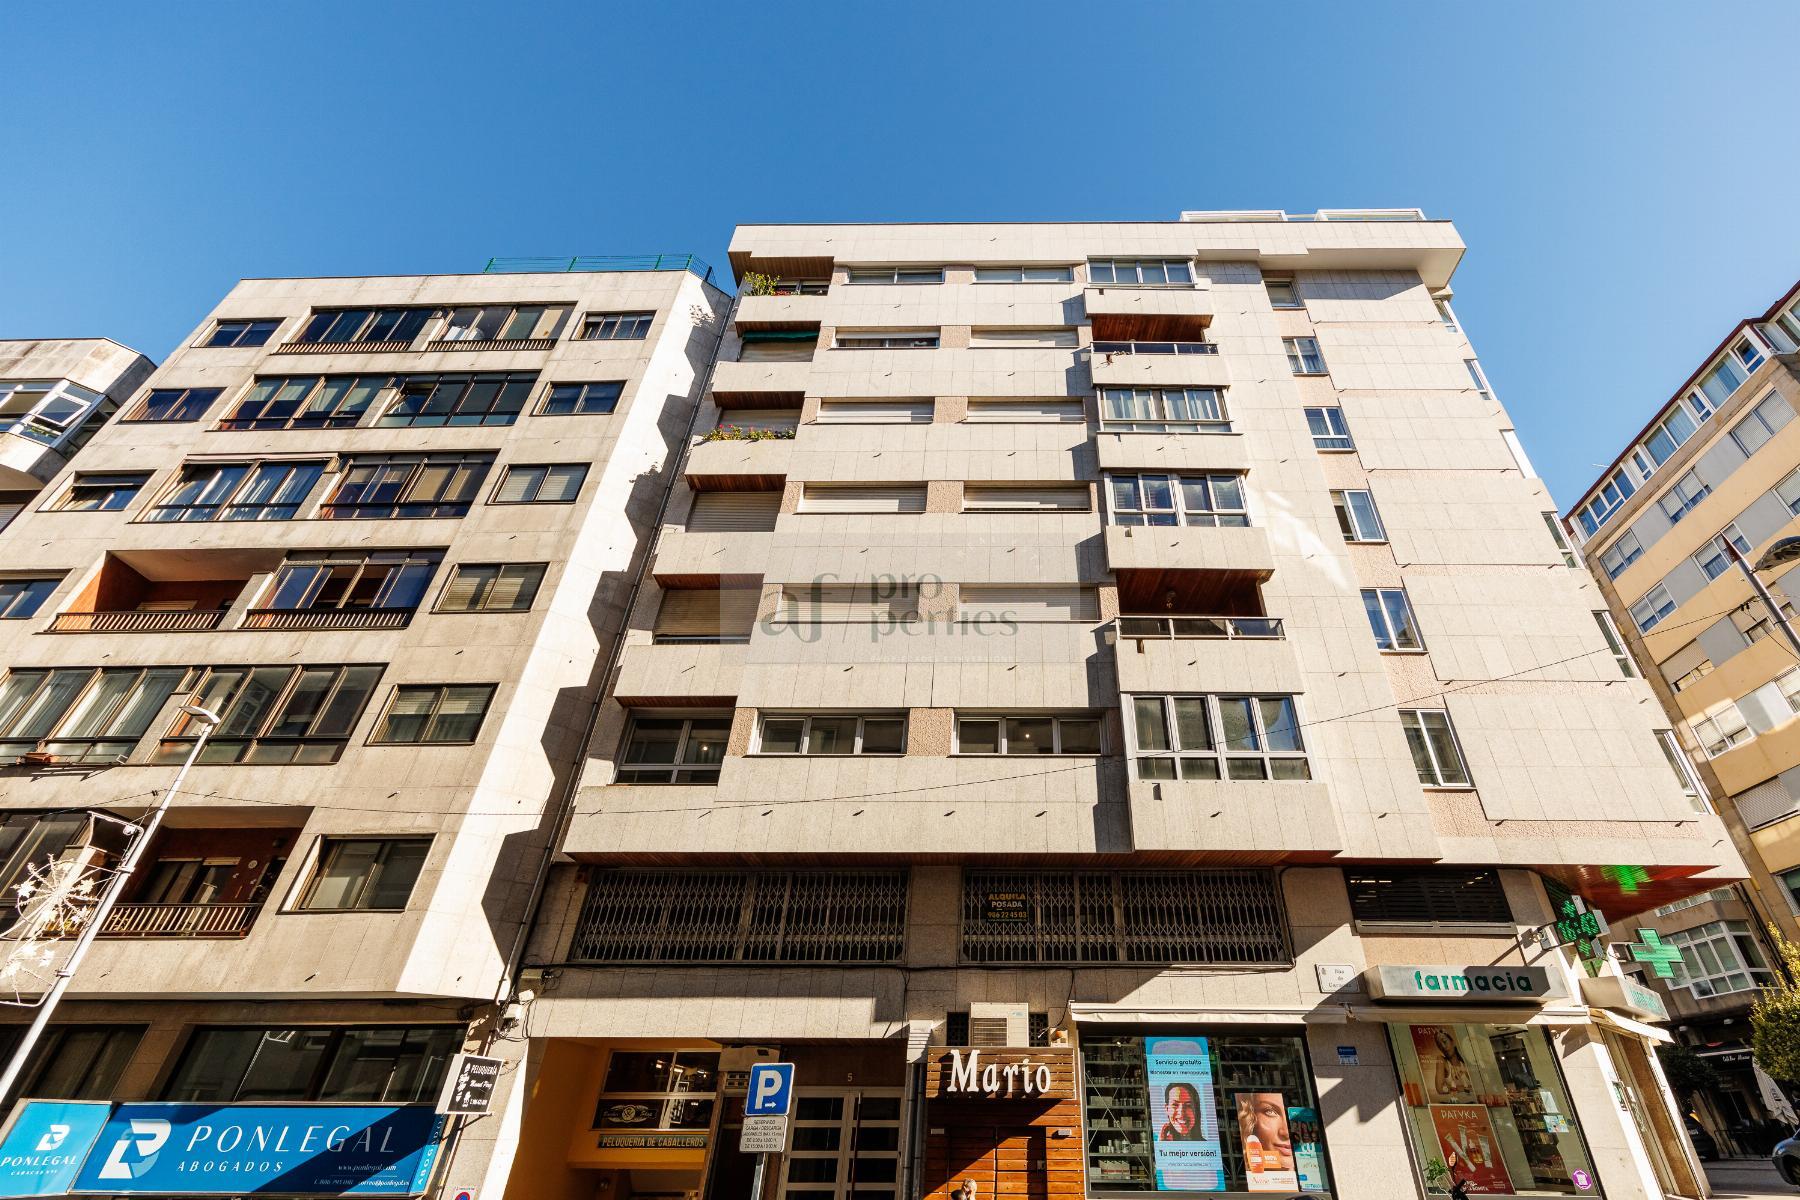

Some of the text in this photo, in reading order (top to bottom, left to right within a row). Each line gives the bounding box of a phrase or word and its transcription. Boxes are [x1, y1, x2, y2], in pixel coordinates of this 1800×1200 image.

[1414, 970, 1533, 991] farmacia
[947, 1049, 1051, 1093] Mario
[847, 1072, 853, 1082] 5
[754, 1069, 783, 1110] P
[1440, 1109, 1479, 1120] PATYKA
[186, 1124, 396, 1153] PONLEGAL
[601, 1137, 704, 1147] PELUQUERIA DE CABALLEROS
[1159, 1149, 1217, 1158] Tu mejor versión!
[0, 1155, 77, 1166] PONLEGAL
[176, 1160, 284, 1172] ABOGADOS
